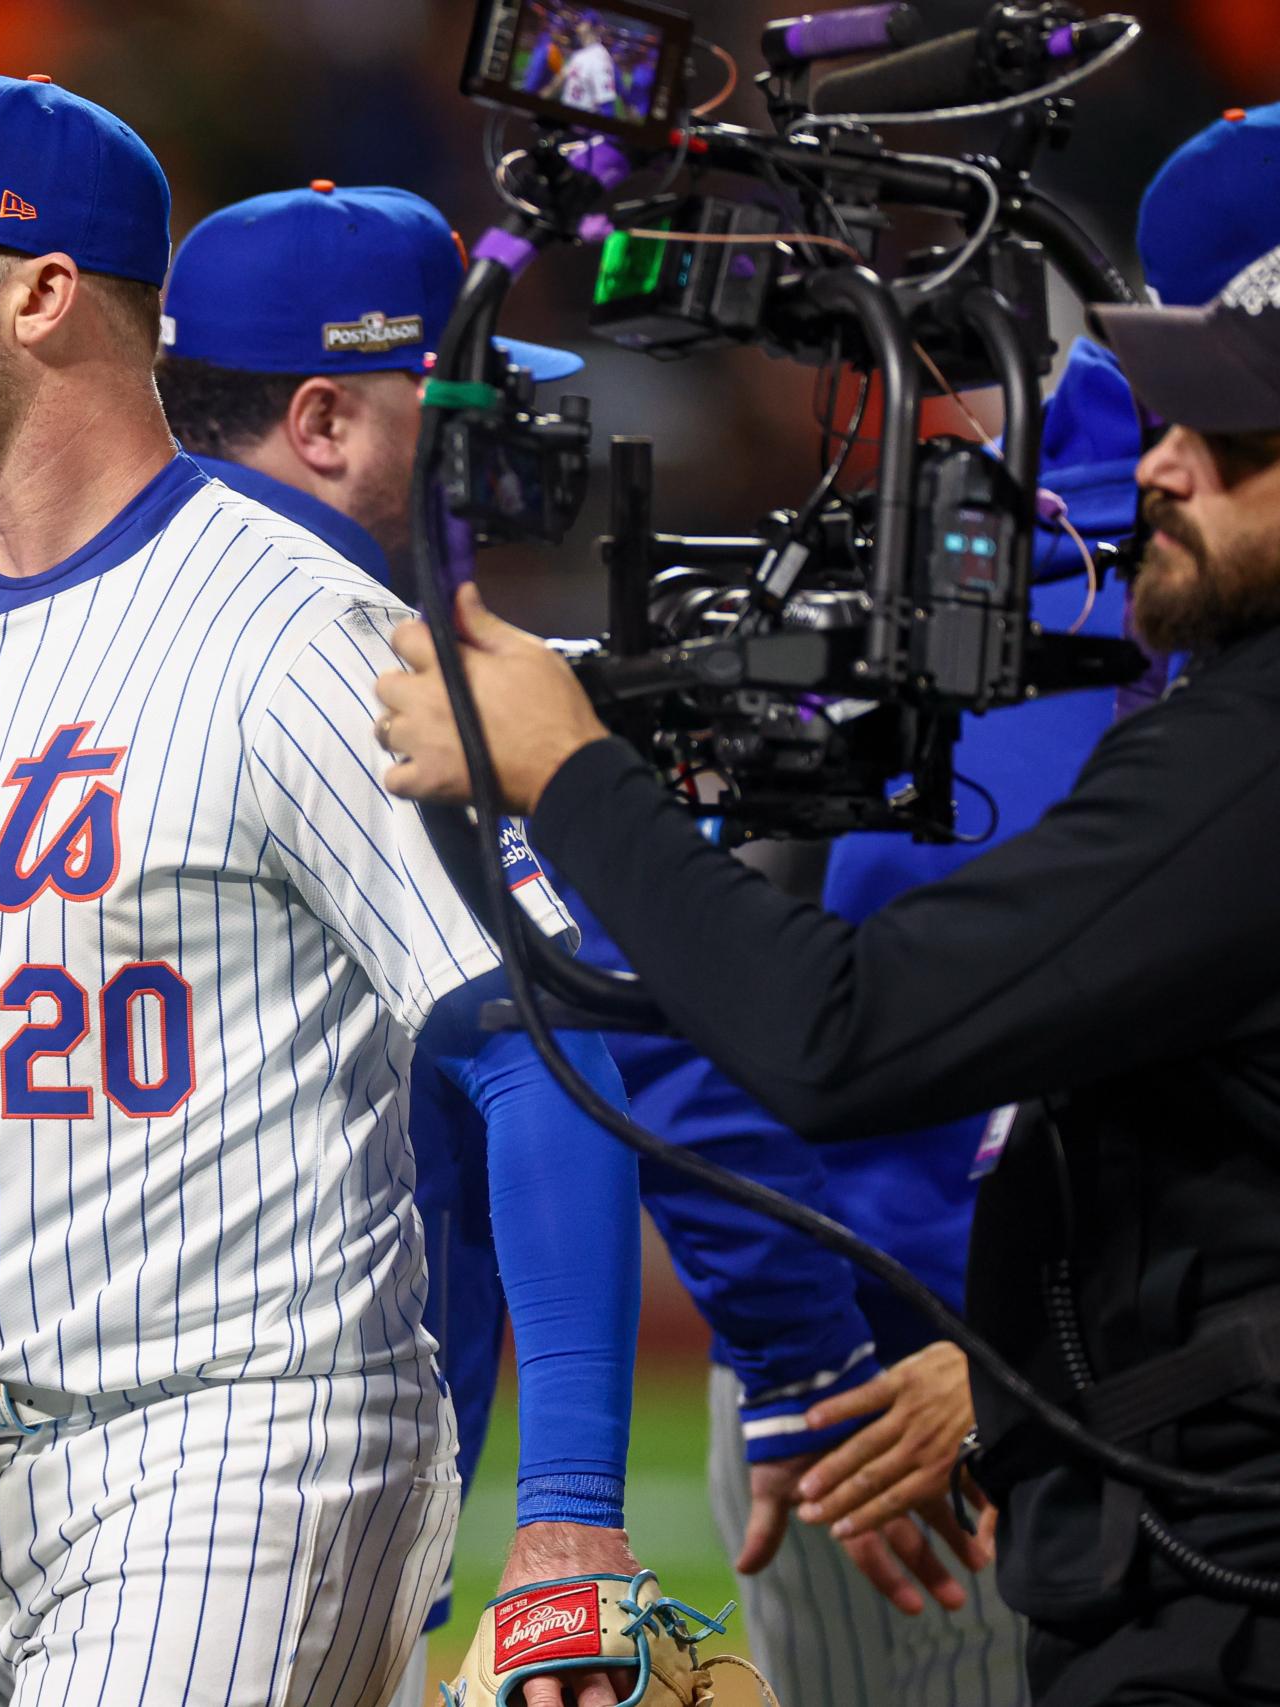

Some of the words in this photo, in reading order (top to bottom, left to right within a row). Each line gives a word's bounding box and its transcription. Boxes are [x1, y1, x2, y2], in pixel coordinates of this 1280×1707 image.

[328, 323, 420, 346] POSTSEASON
[501, 844, 533, 868] esby
[502, 1606, 588, 1650] Rawlings
